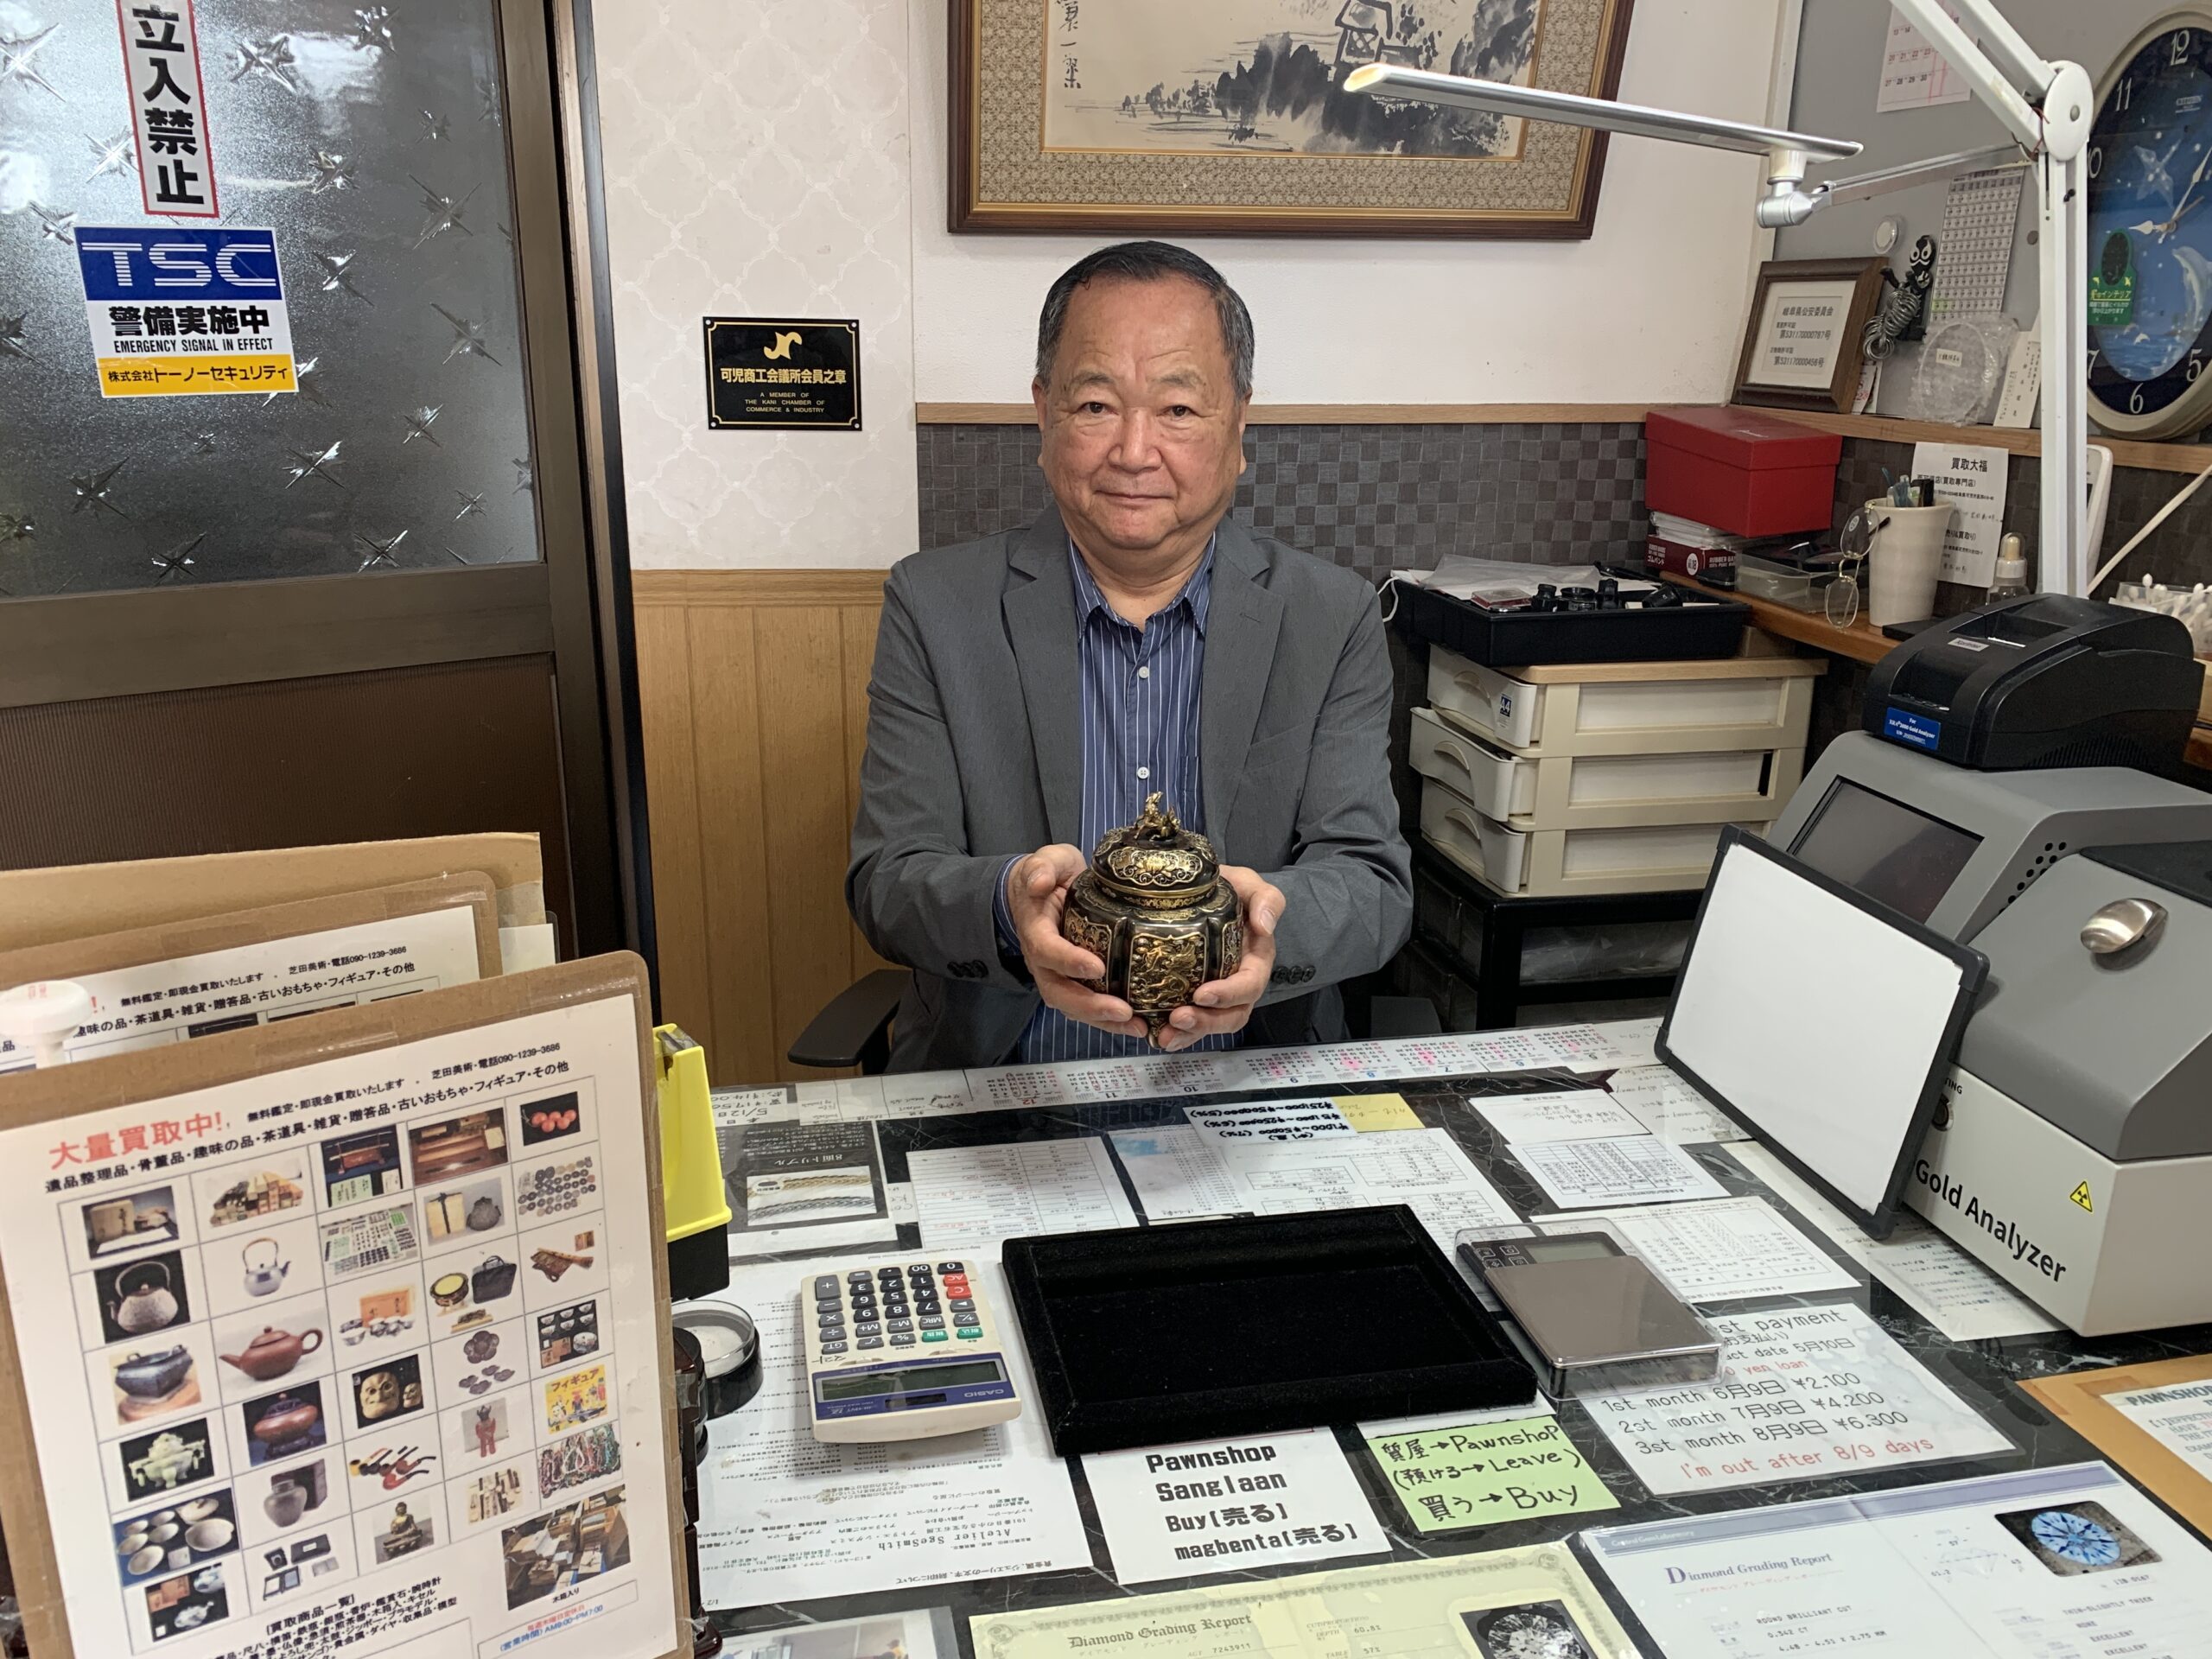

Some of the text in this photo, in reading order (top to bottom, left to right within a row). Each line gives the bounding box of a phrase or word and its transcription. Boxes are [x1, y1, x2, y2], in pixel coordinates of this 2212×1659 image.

[2170, 29, 2190, 67] 12
[132, 4, 205, 205] 立入禁止
[2116, 77, 2132, 111] 11
[81, 242, 277, 288] TSC
[109, 305, 270, 337] 警備実施中
[114, 338, 274, 353] EMERGENCY SIGNAL IN EFFECT
[107, 365, 289, 384] 株式会社トーノーセキュリティ
[2088, 348, 2203, 382] 7 5
[2129, 383, 2144, 414] 6
[1951, 457, 1988, 473] 買取大福
[1647, 555, 1665, 566] ゴムバンド
[1916, 1159, 1963, 1209] Gold
[1965, 1196, 2067, 1282] Analyzer
[860, 1295, 868, 1304] 6
[921, 1288, 931, 1297] 4
[893, 1305, 902, 1313] 8
[921, 1316, 942, 1325] MRC
[1755, 1309, 1847, 1332] payment
[1755, 1338, 1856, 1358] date 5月10日
[1745, 1363, 1771, 1376] yen
[1777, 1359, 1809, 1371] loan
[550, 1369, 600, 1393] フィギュア
[1601, 1371, 1861, 1414] 1st month 6月9日 ¥2.100
[964, 1389, 1004, 1398] CASIO
[1618, 1391, 1885, 1435] 2st month 7月9日 ¥4.200
[1635, 1411, 1908, 1455] 3st month 8月9日 ¥6.300
[1145, 1445, 1277, 1473] Pawnshop
[1382, 1439, 1429, 1463] 質屋
[1680, 1436, 1934, 1479] I'm out after 8/9 days
[1155, 1473, 1287, 1502] Sanglaan
[1418, 1484, 1578, 1522] 買う Buy
[878, 1535, 944, 1551] SgeSmith
[954, 1528, 1011, 1541] Atelier
[1664, 1565, 1735, 1586] Diamond
[1737, 1559, 1789, 1574] Grading
[1791, 1553, 1833, 1567] Report
[1787, 1607, 1833, 1621] BRILLIANT
[1067, 1630, 1134, 1649] Diamond
[1138, 1624, 1197, 1639] Grading
[1201, 1613, 1252, 1631] Report
[2089, 1630, 2134, 1643] EXCELLENT
[2104, 1643, 2148, 1656] EXCELLENT
